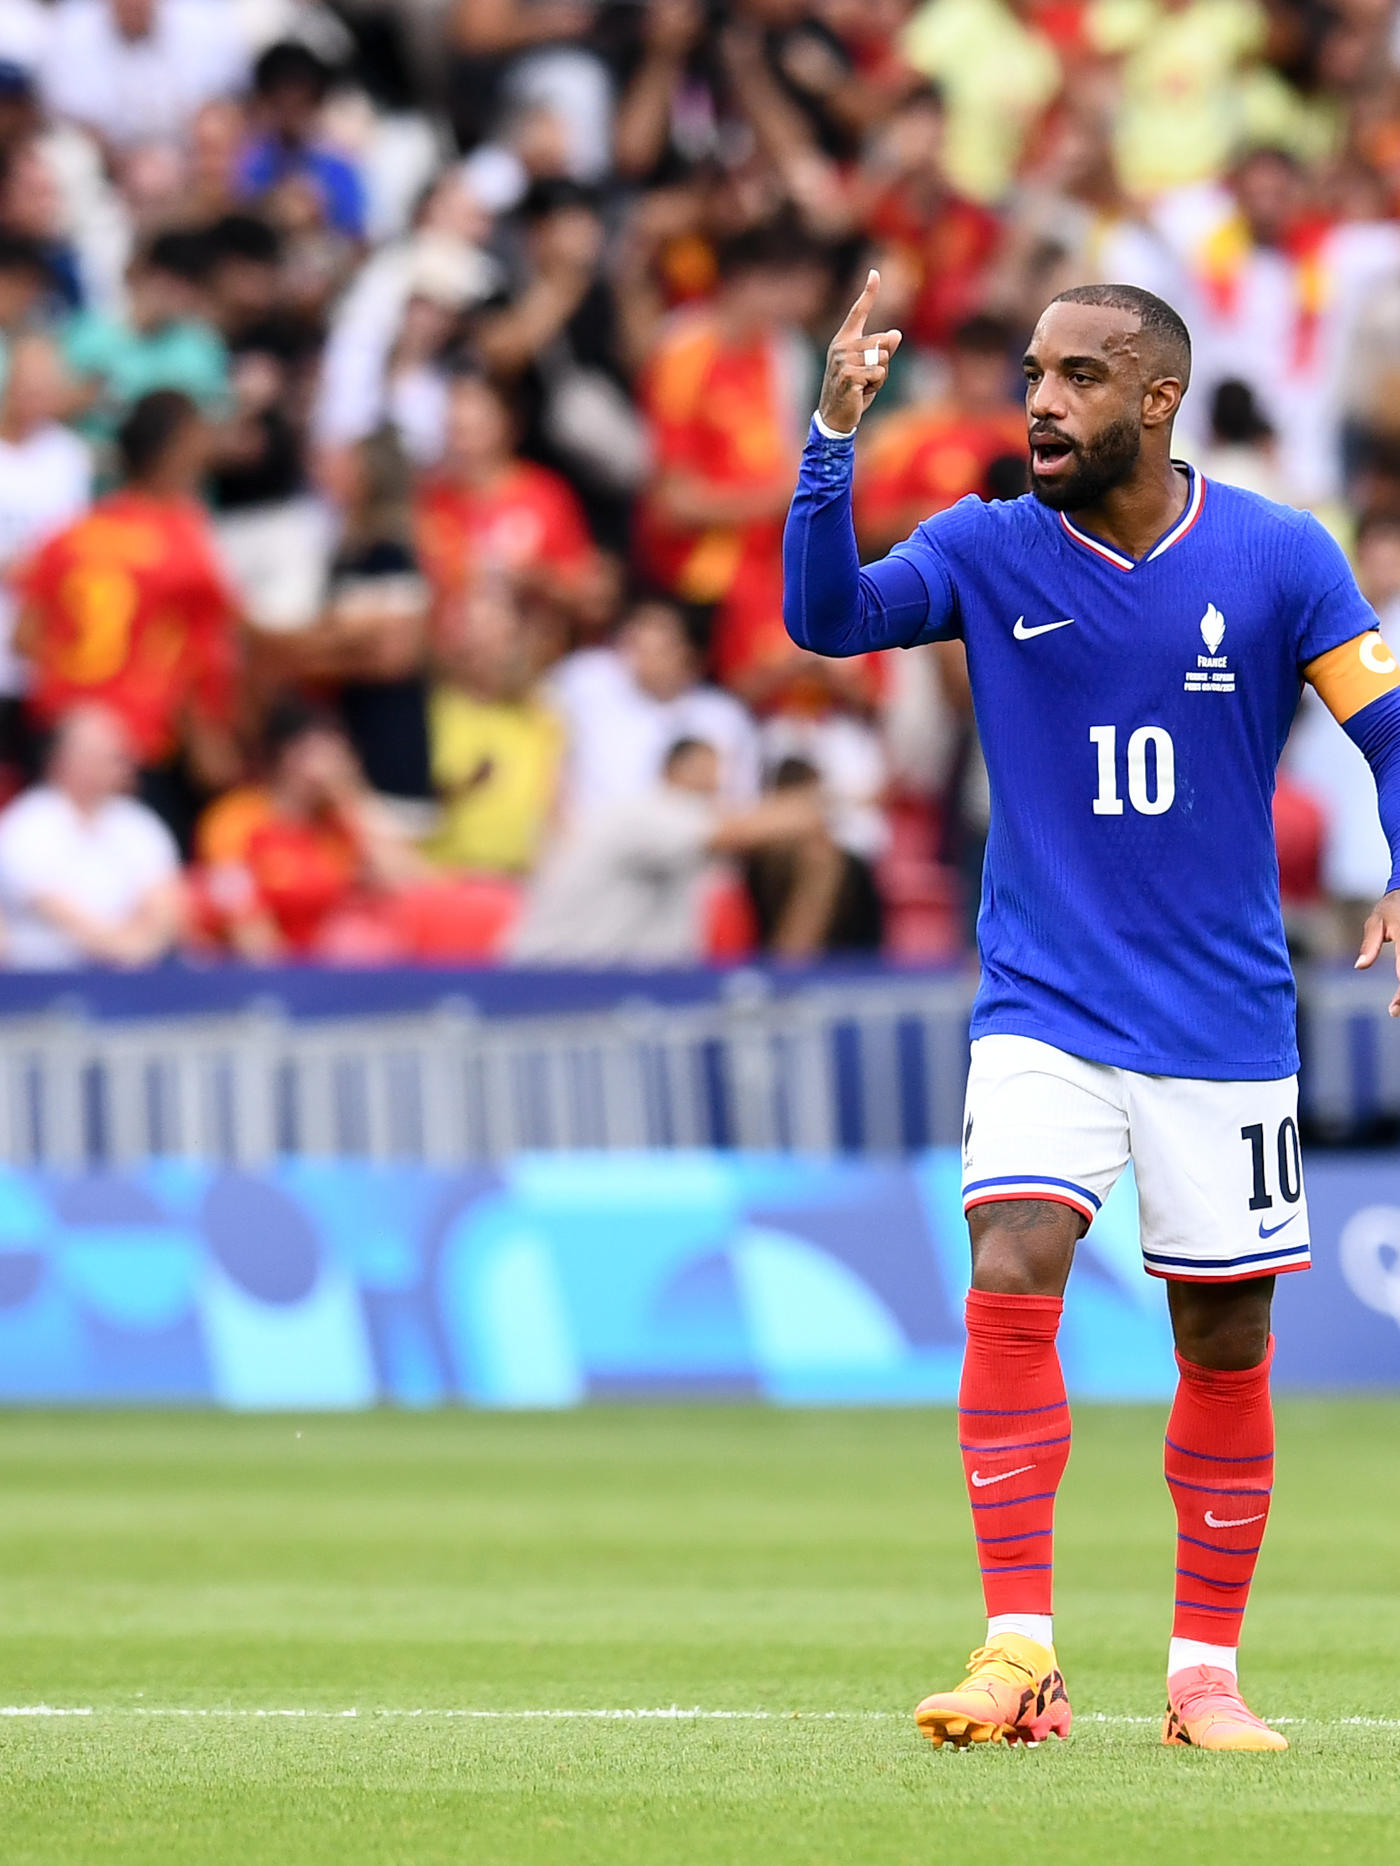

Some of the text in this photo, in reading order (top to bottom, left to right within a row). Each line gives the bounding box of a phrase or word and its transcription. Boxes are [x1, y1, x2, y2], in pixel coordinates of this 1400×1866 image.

[1197, 654, 1228, 668] FRANCE
[1359, 632, 1397, 674] C
[1089, 725, 1175, 815] 10
[1241, 1116, 1301, 1211] 10
